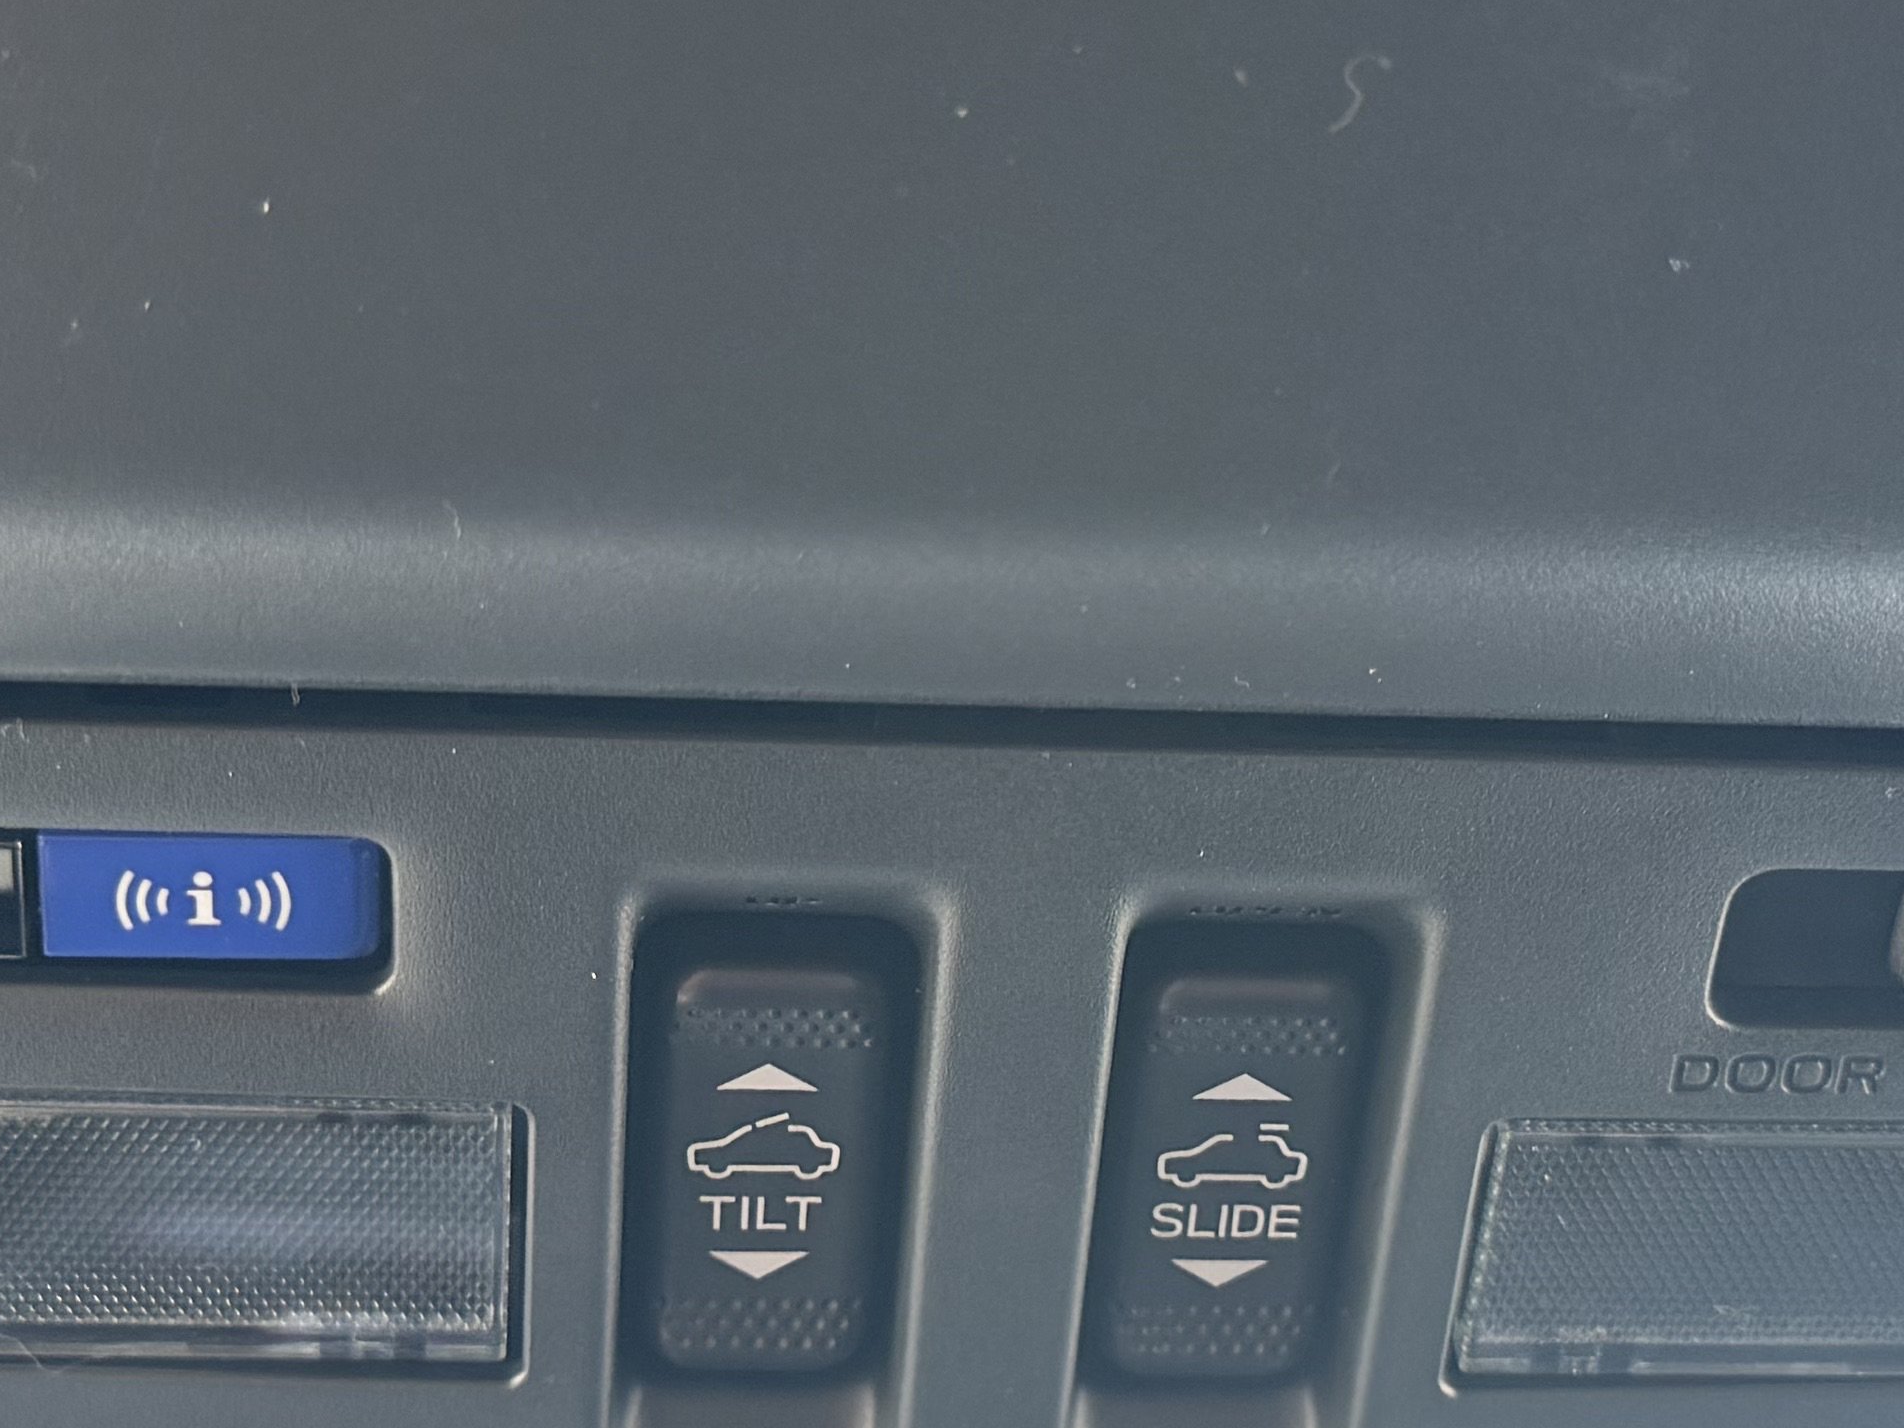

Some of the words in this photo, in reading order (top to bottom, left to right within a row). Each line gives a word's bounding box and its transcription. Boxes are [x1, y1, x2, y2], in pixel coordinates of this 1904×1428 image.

[1668, 1053, 1886, 1096] DOOR
[700, 1196, 822, 1231] TILT
[1150, 1203, 1302, 1239] SLIDE
